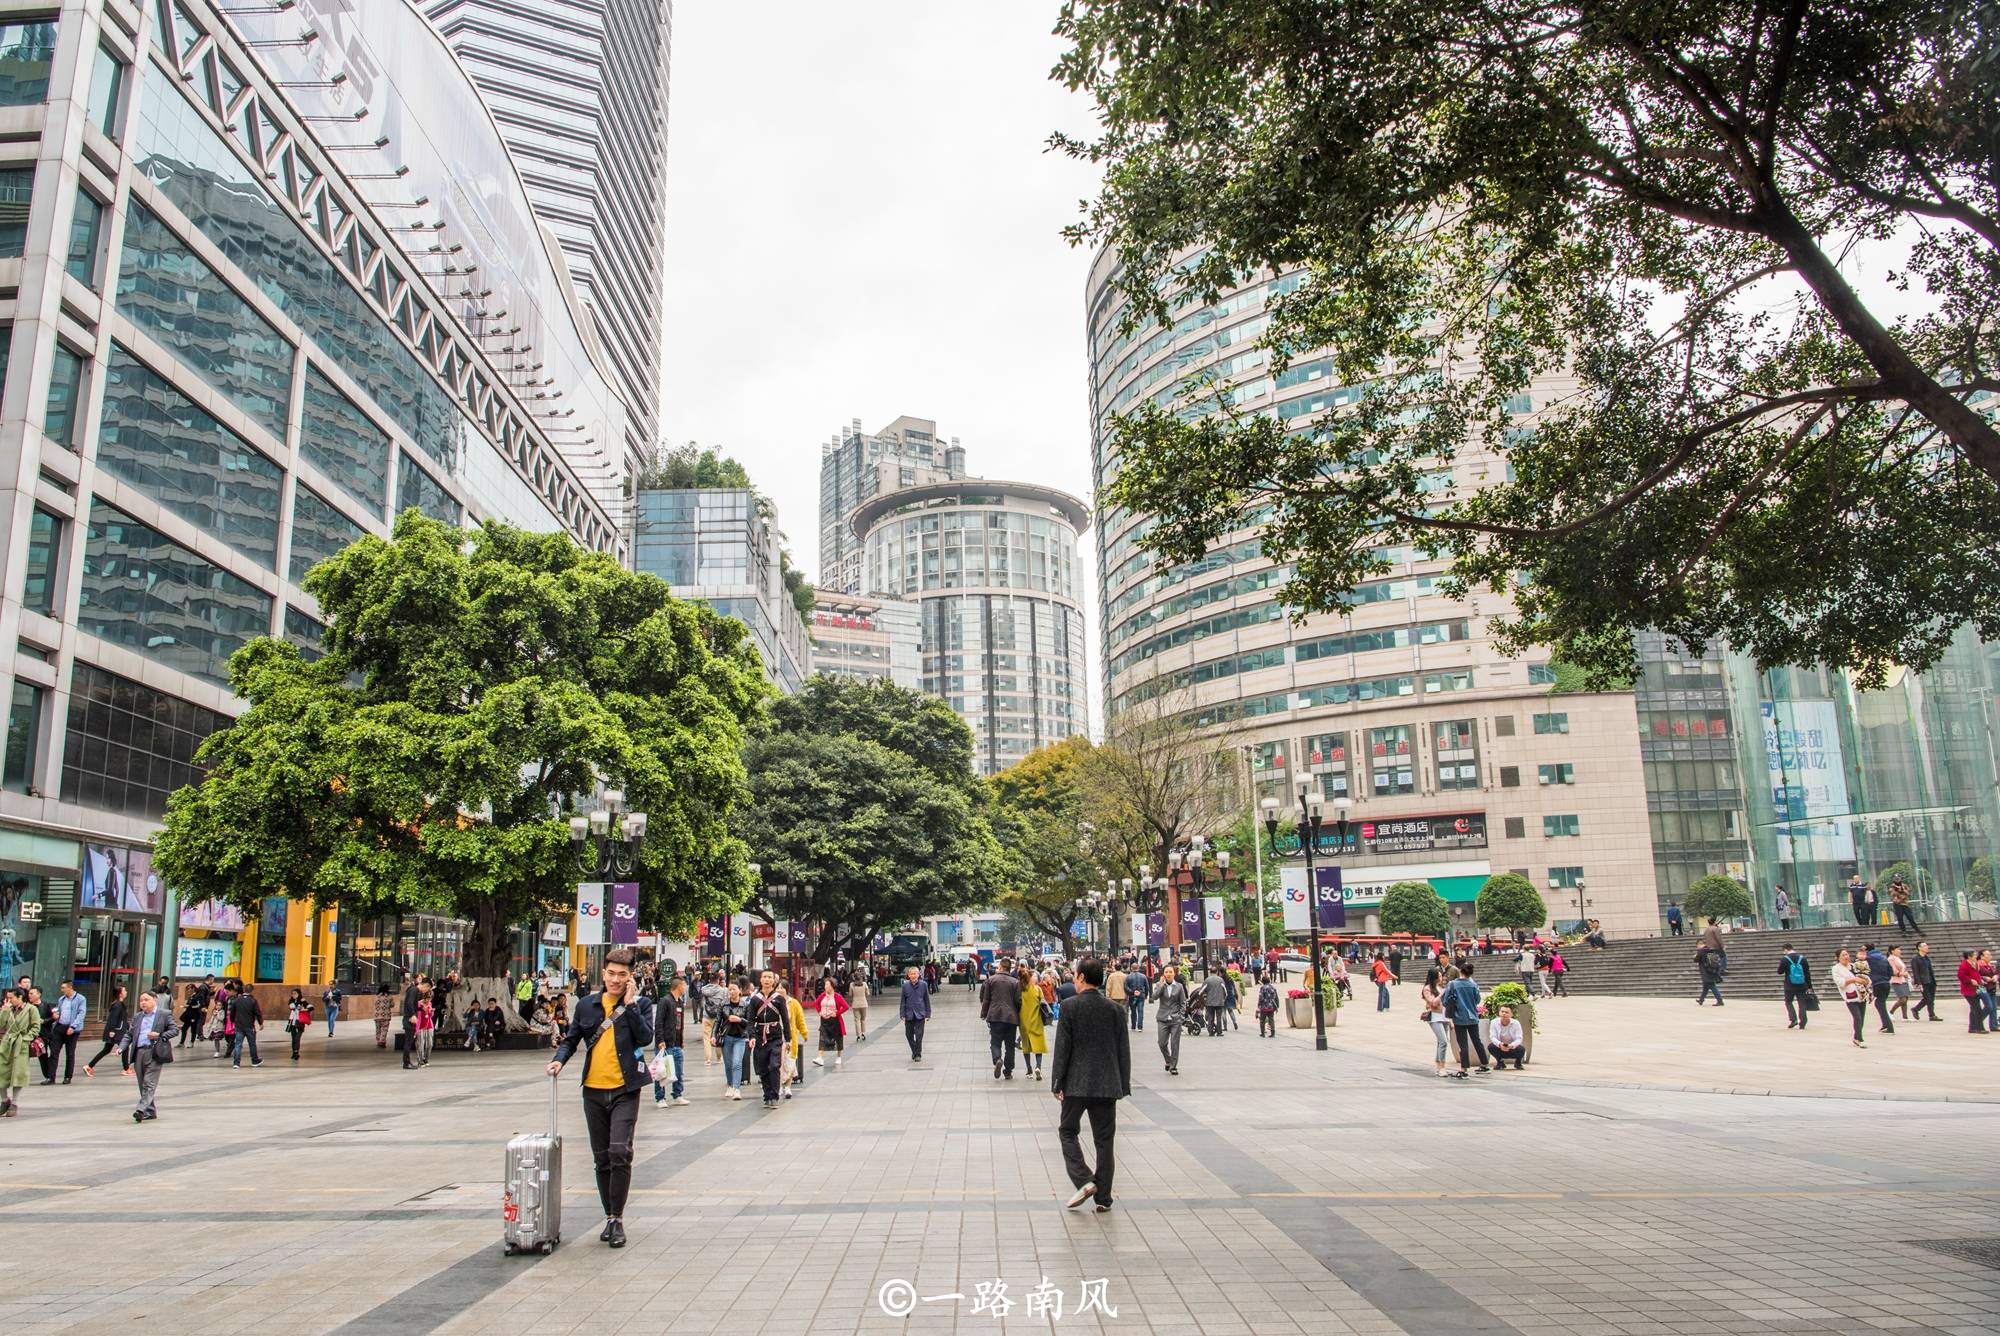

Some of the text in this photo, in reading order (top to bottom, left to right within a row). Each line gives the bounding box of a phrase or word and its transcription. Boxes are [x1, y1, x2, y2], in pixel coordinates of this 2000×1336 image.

[1378, 821, 1429, 836] 宜尚酒店
[1286, 888, 1305, 903] 5G
[1320, 886, 1341, 902] 5G
[580, 901, 600, 917] 5G
[614, 903, 636, 919] 5G
[1183, 911, 1199, 923] 5G
[1208, 911, 1221, 921] 5G
[709, 926, 724, 938] 5G
[733, 926, 747, 937] 5G
[1134, 923, 1145, 932] 5G
[1151, 923, 1163, 933] 5G
[777, 931, 787, 939] 5G
[793, 930, 806, 940] 5G
[177, 946, 225, 968] 生活超市
